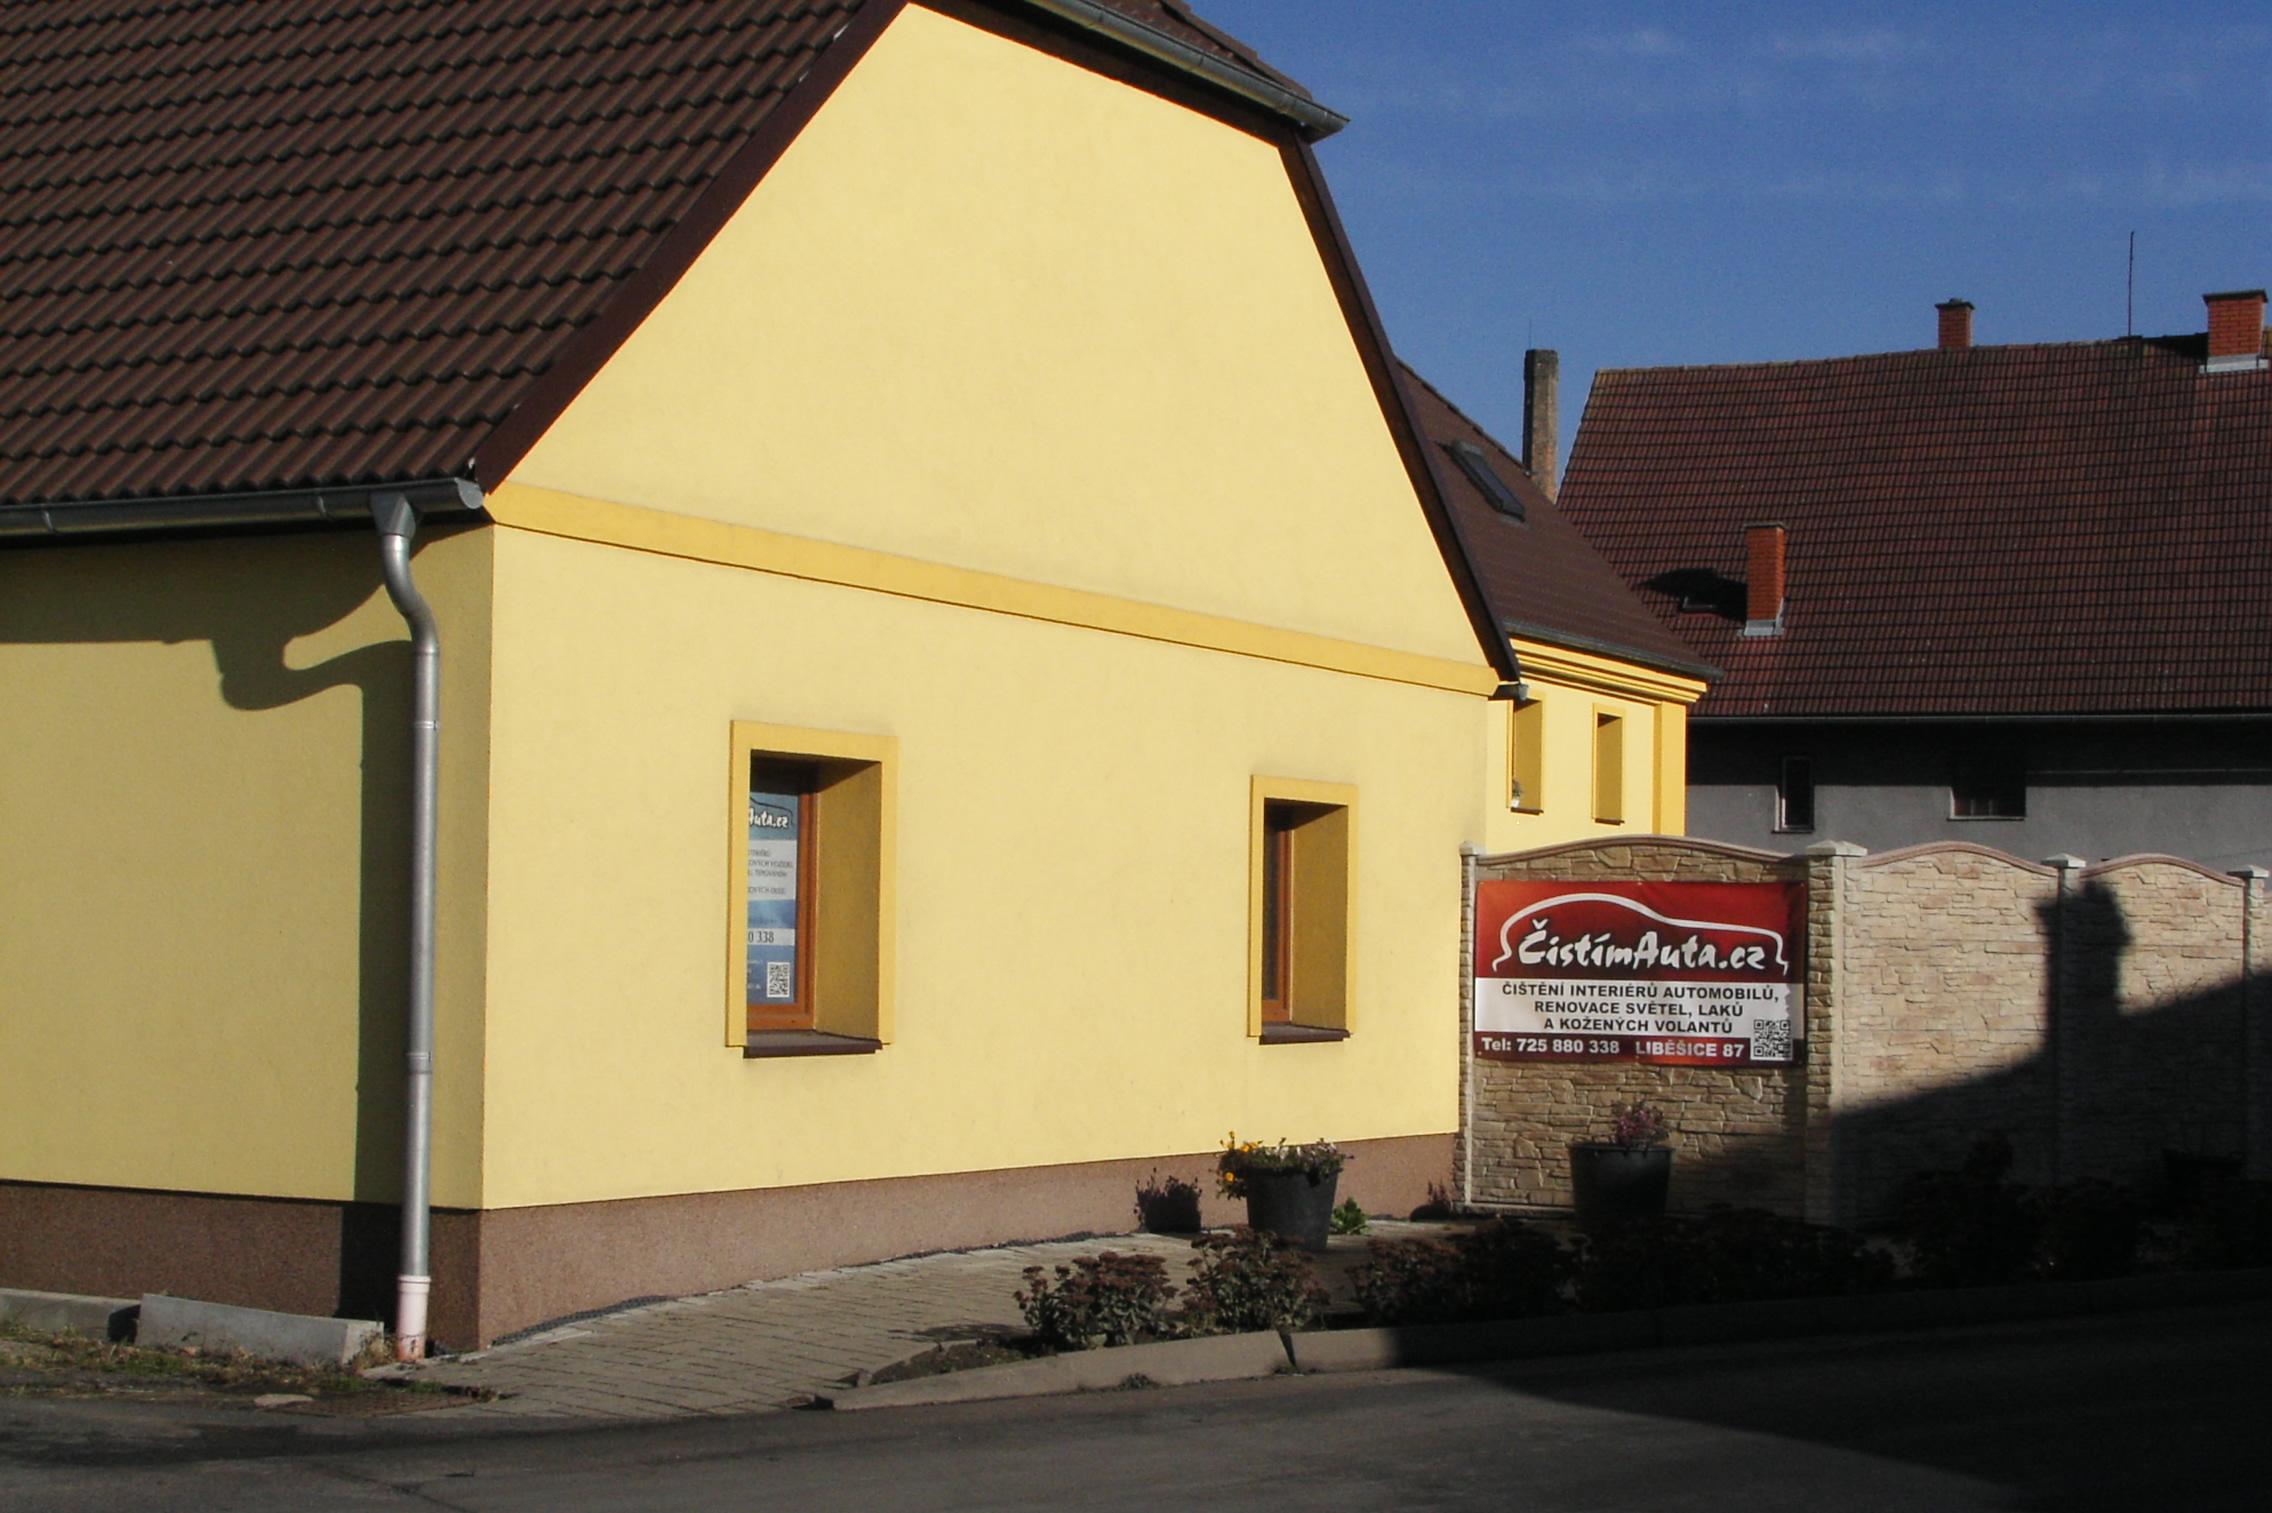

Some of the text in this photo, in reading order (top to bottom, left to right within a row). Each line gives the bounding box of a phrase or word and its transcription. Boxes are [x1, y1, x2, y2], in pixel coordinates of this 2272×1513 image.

[757, 931, 774, 943] 338
[1518, 918, 1766, 970] ČistímAuta.cz
[1502, 981, 1779, 1002] ČIŠTĚNÍ INTERIÉRŮ AUTOMOBILŮ,
[1535, 1001, 1743, 1017] RENOVACE SVĚTEL, LAKŮ
[1544, 1016, 1732, 1033] A KOŽENÝCH VOLANTŮ
[1481, 1037, 1744, 1057] Tel: 725 880 338 LIBĚŠICE 87
